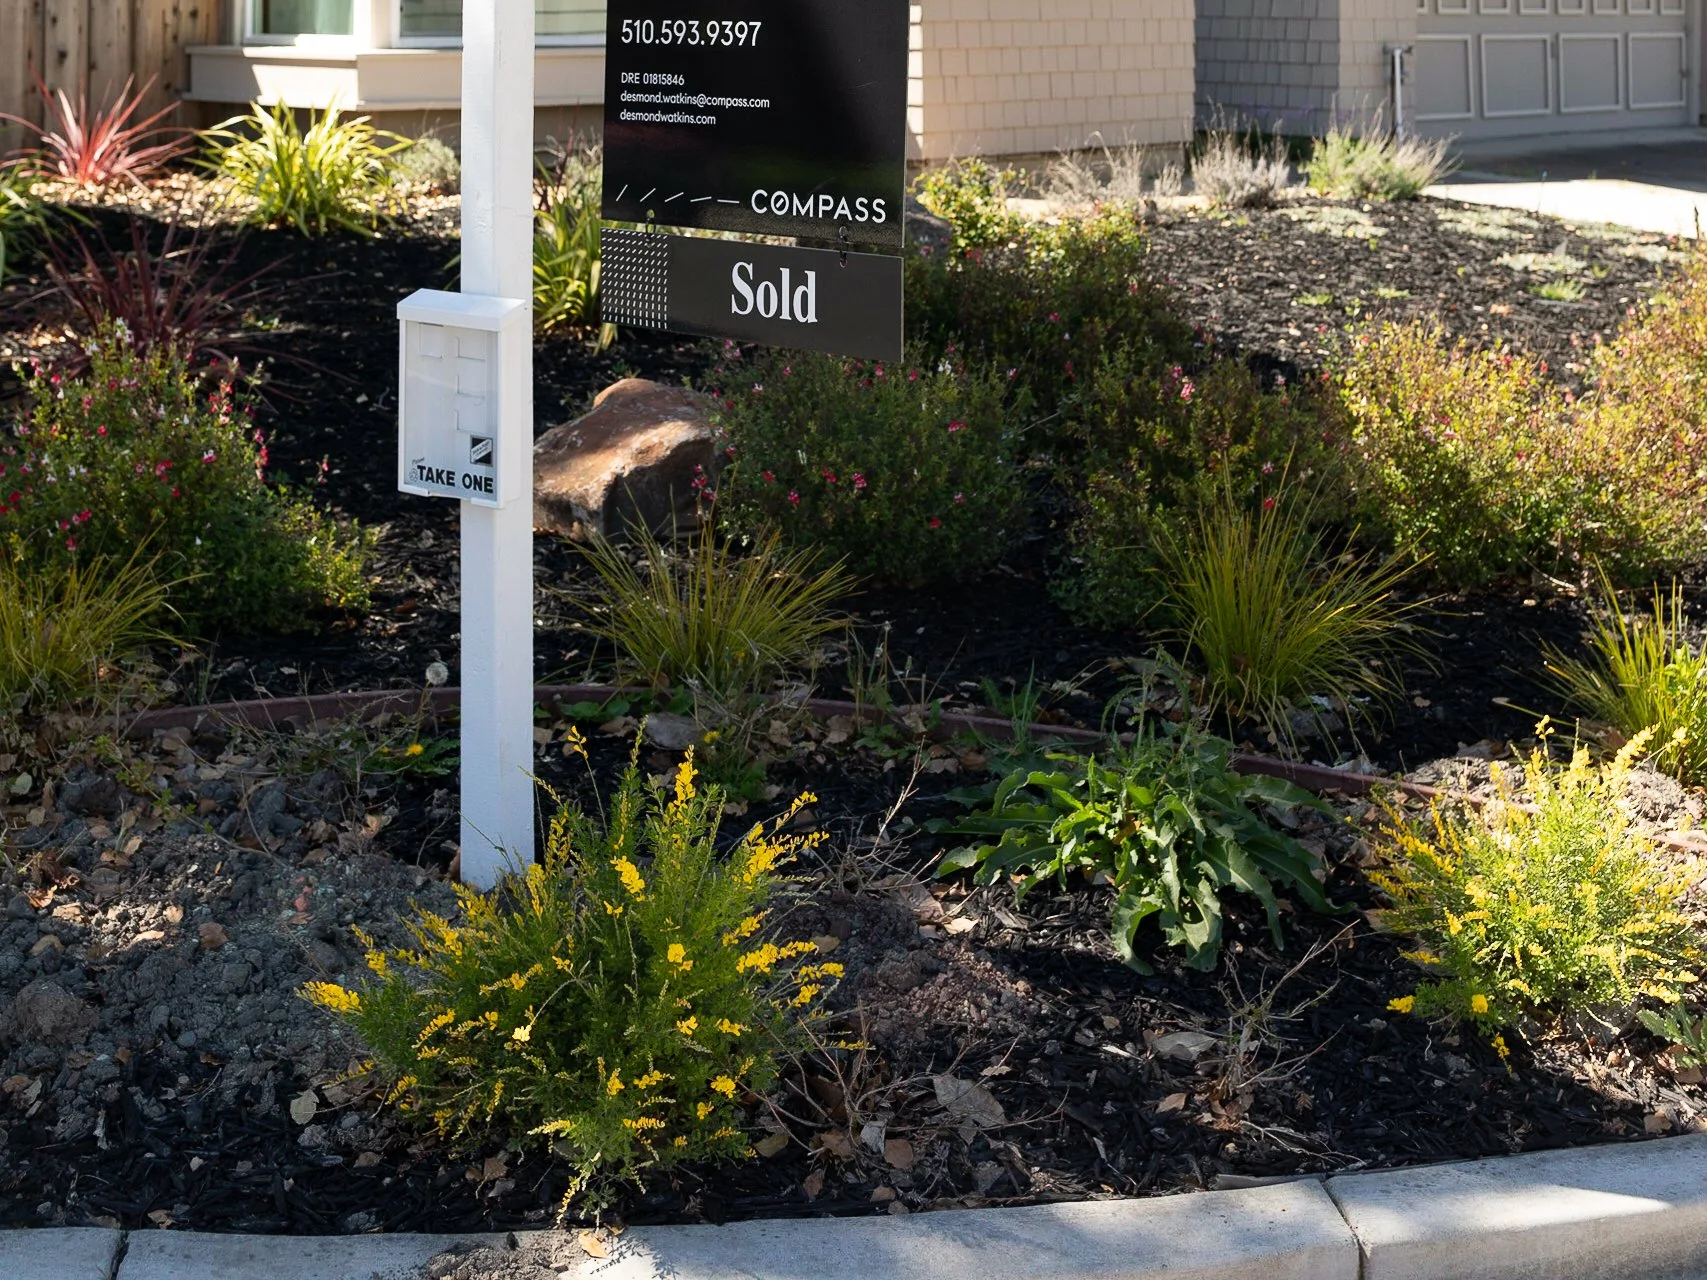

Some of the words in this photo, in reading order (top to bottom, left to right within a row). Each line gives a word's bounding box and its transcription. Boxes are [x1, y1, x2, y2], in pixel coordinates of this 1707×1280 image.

[621, 19, 762, 47] 510.593.9397
[620, 72, 641, 84] DRE
[642, 72, 685, 86] 01815846
[620, 90, 770, 109] desmond.watkins@compass.com
[619, 108, 716, 125] desmondwatkins.com
[750, 188, 887, 224] COMPASS
[731, 261, 818, 324] Sold
[416, 464, 456, 487] TAKE
[461, 472, 495, 494] ONE
